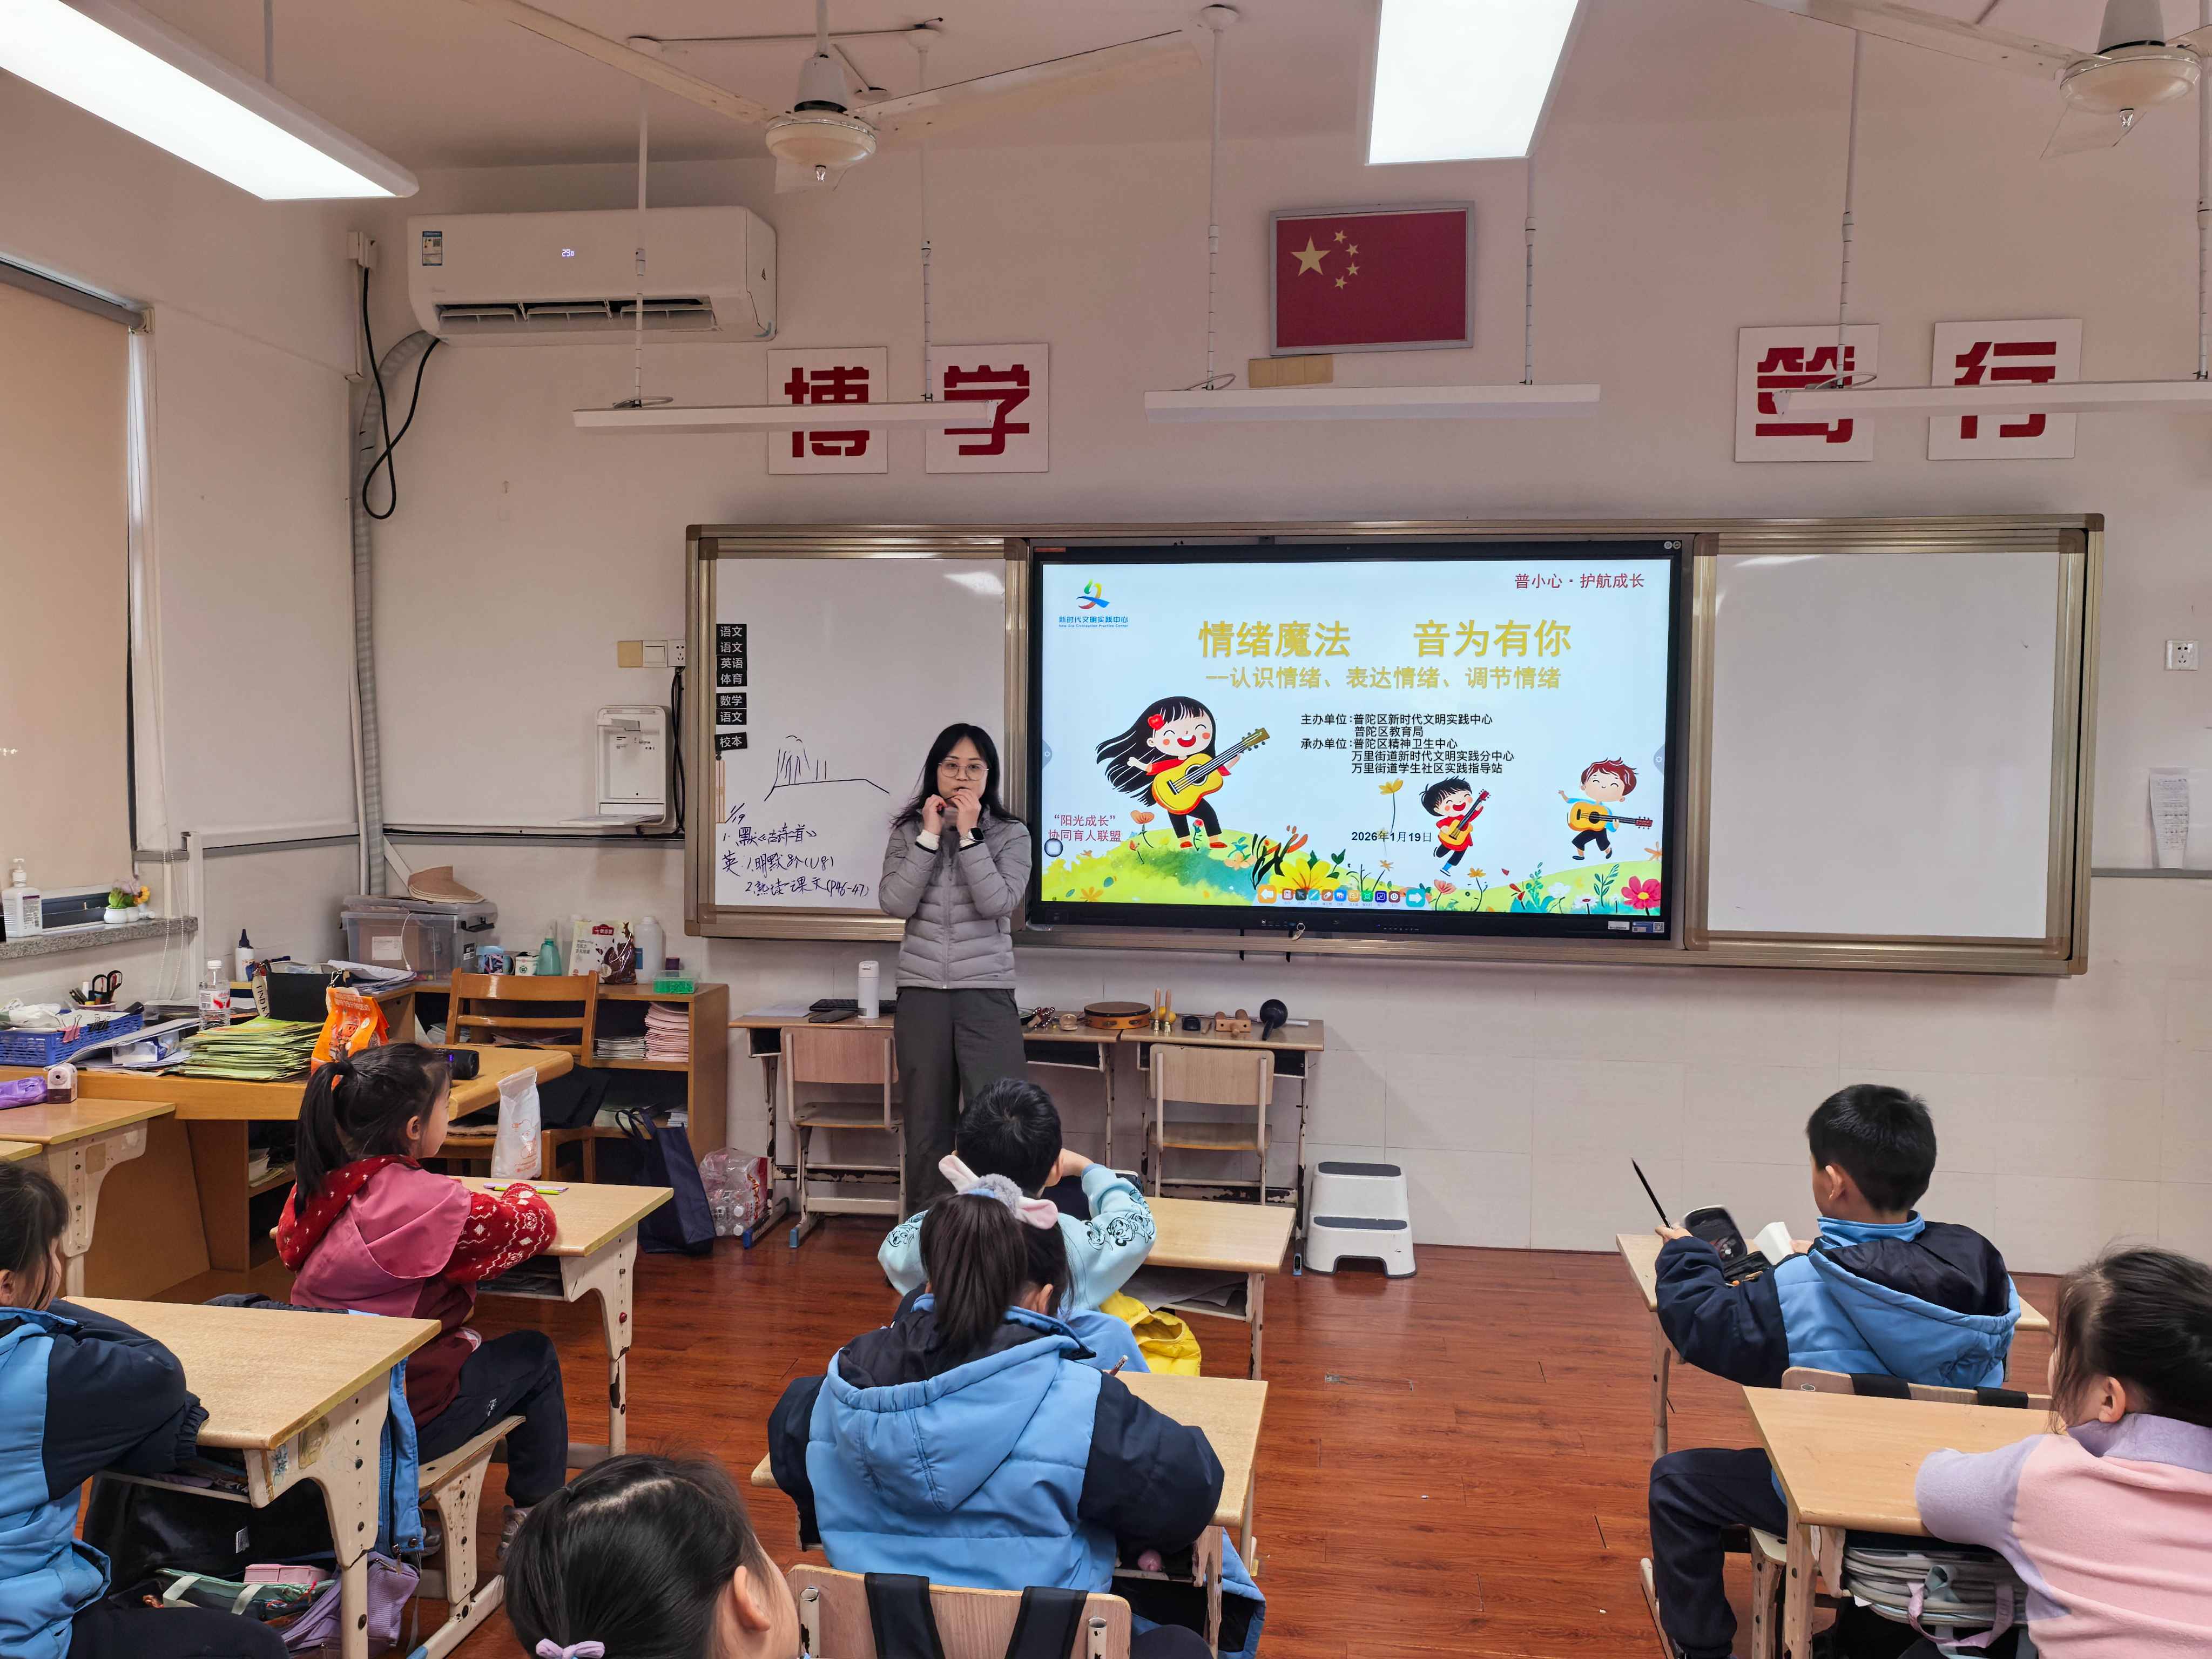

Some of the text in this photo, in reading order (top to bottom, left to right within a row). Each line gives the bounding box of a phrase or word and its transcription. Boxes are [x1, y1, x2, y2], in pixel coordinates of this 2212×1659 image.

[720, 626, 743, 637] 语文
[1198, 619, 1571, 657] 情绪魔法 音为有你
[720, 642, 743, 653] 语文
[721, 657, 743, 669] 英语
[720, 673, 743, 685] 体育
[720, 694, 743, 706] 数学
[720, 711, 743, 723] 语文
[1354, 726, 1424, 737] 普陀区教育局
[720, 736, 742, 748] 校本
[1352, 750, 1514, 762] 万里街道新时代文明实践分中心
[1352, 763, 1503, 774] 万里街道学生社区实践指导站
[1048, 829, 1121, 842] 协同育人联盟
[1351, 831, 1432, 842] 2026年1月19日
